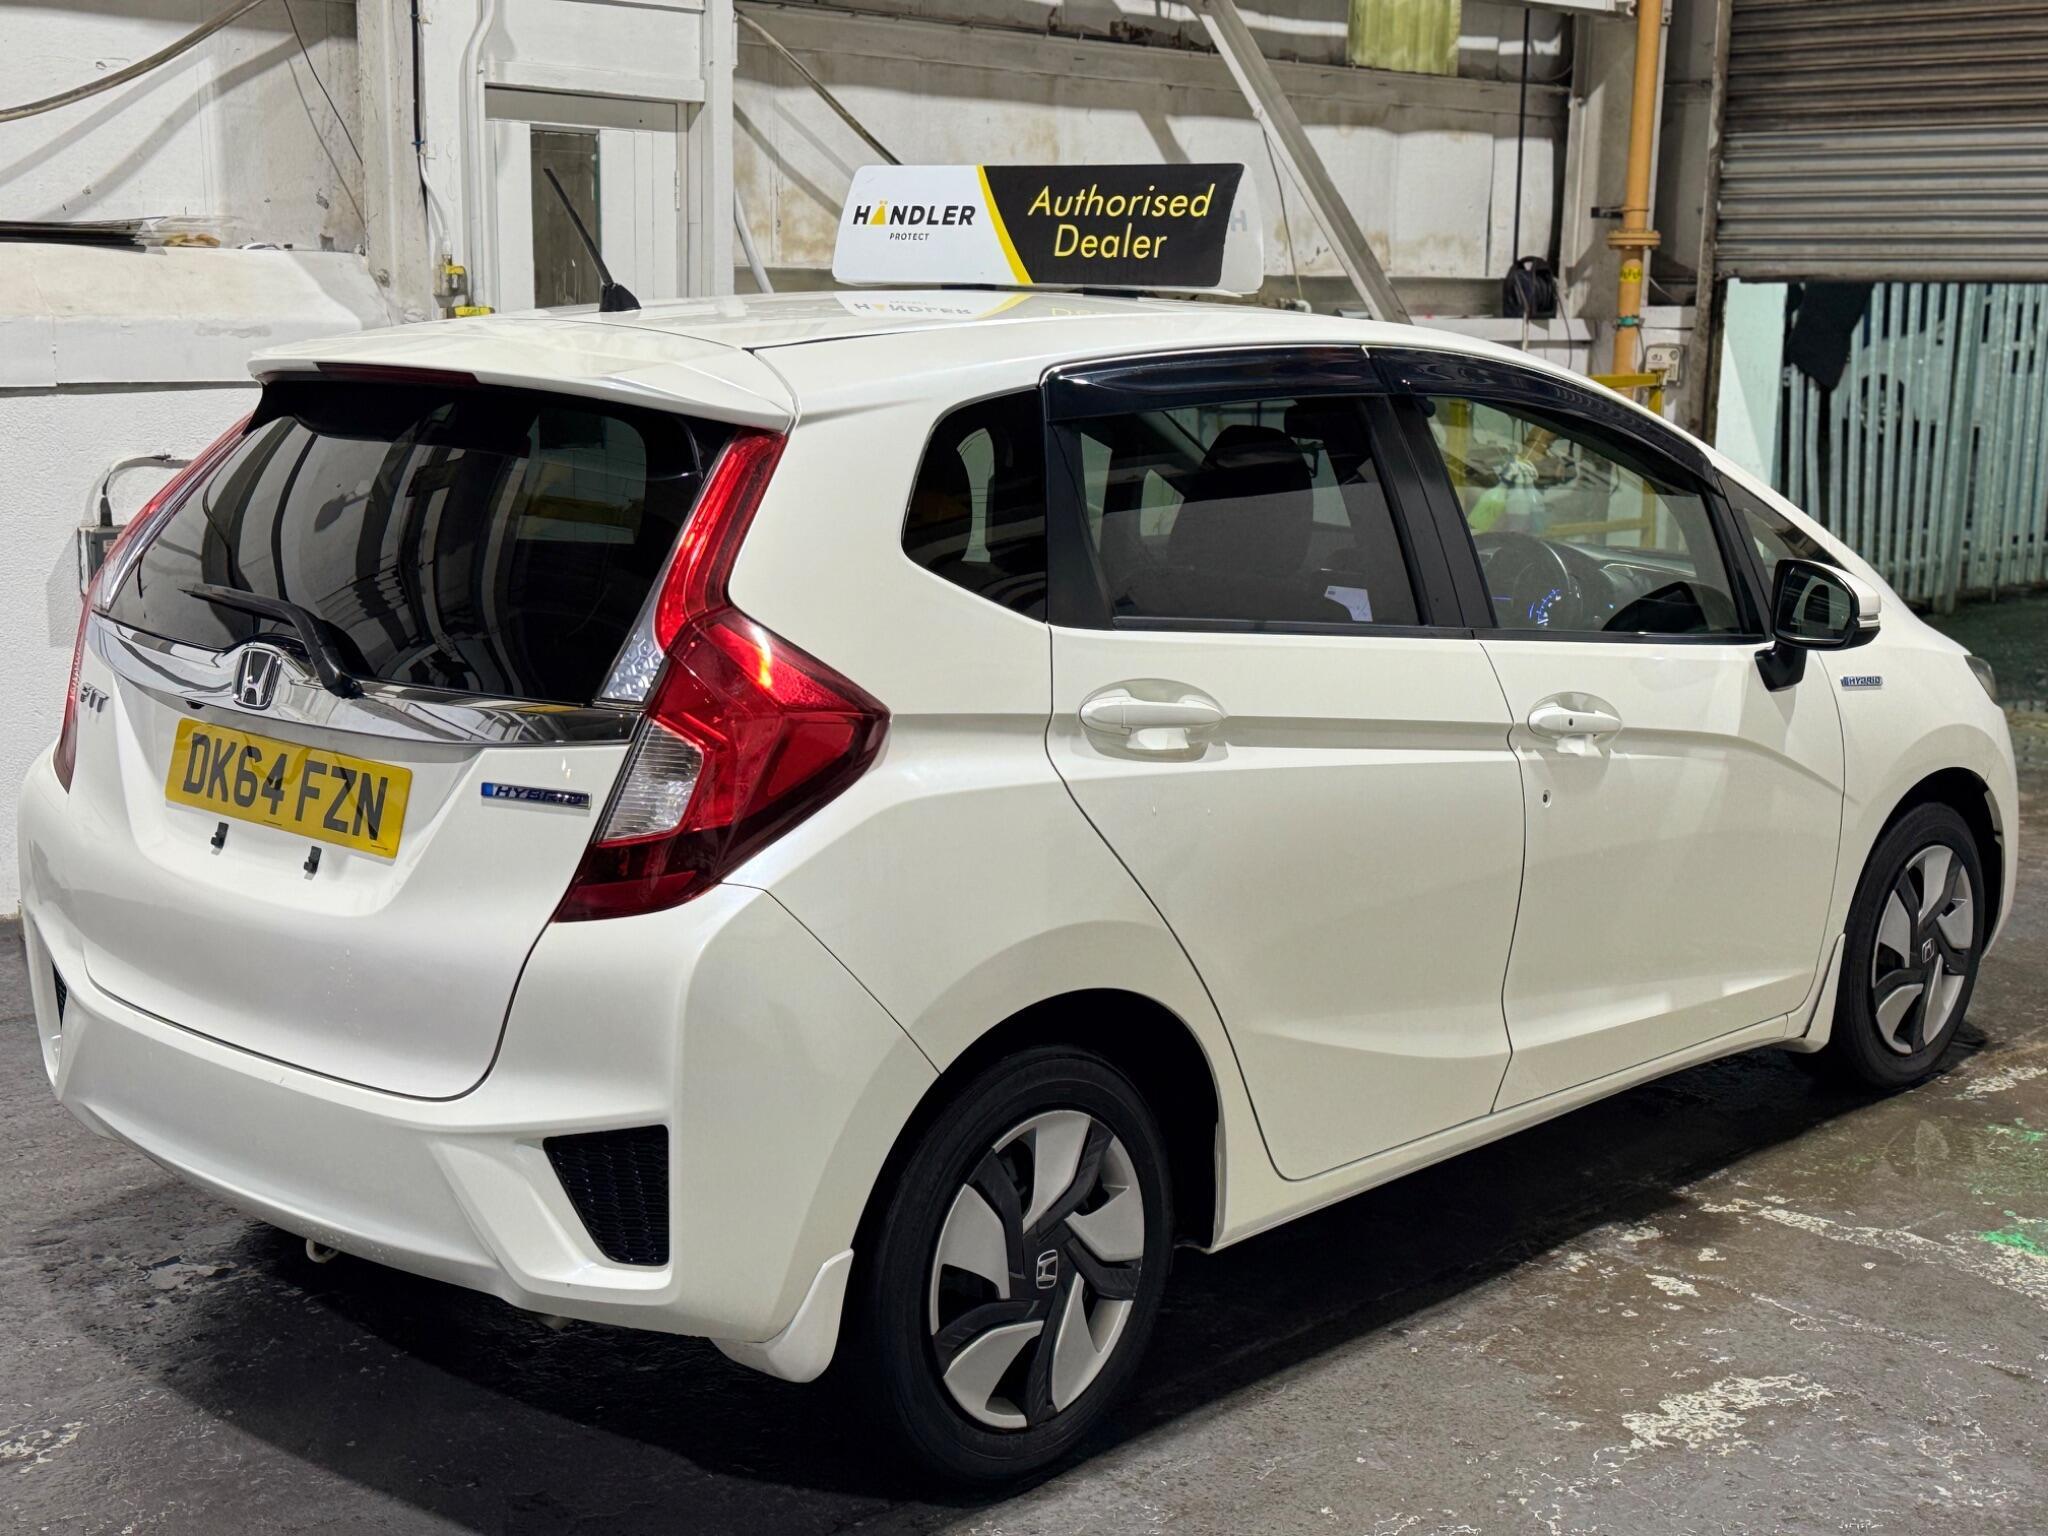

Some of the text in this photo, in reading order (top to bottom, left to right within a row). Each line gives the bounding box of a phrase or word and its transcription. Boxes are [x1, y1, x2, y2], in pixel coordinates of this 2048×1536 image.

[1027, 183, 1216, 217] Authorised
[889, 232, 930, 241] PROTECT
[1053, 222, 1168, 259] Dealer
[182, 732, 388, 841] DK64 FZN
[493, 784, 585, 806] HYBRID
